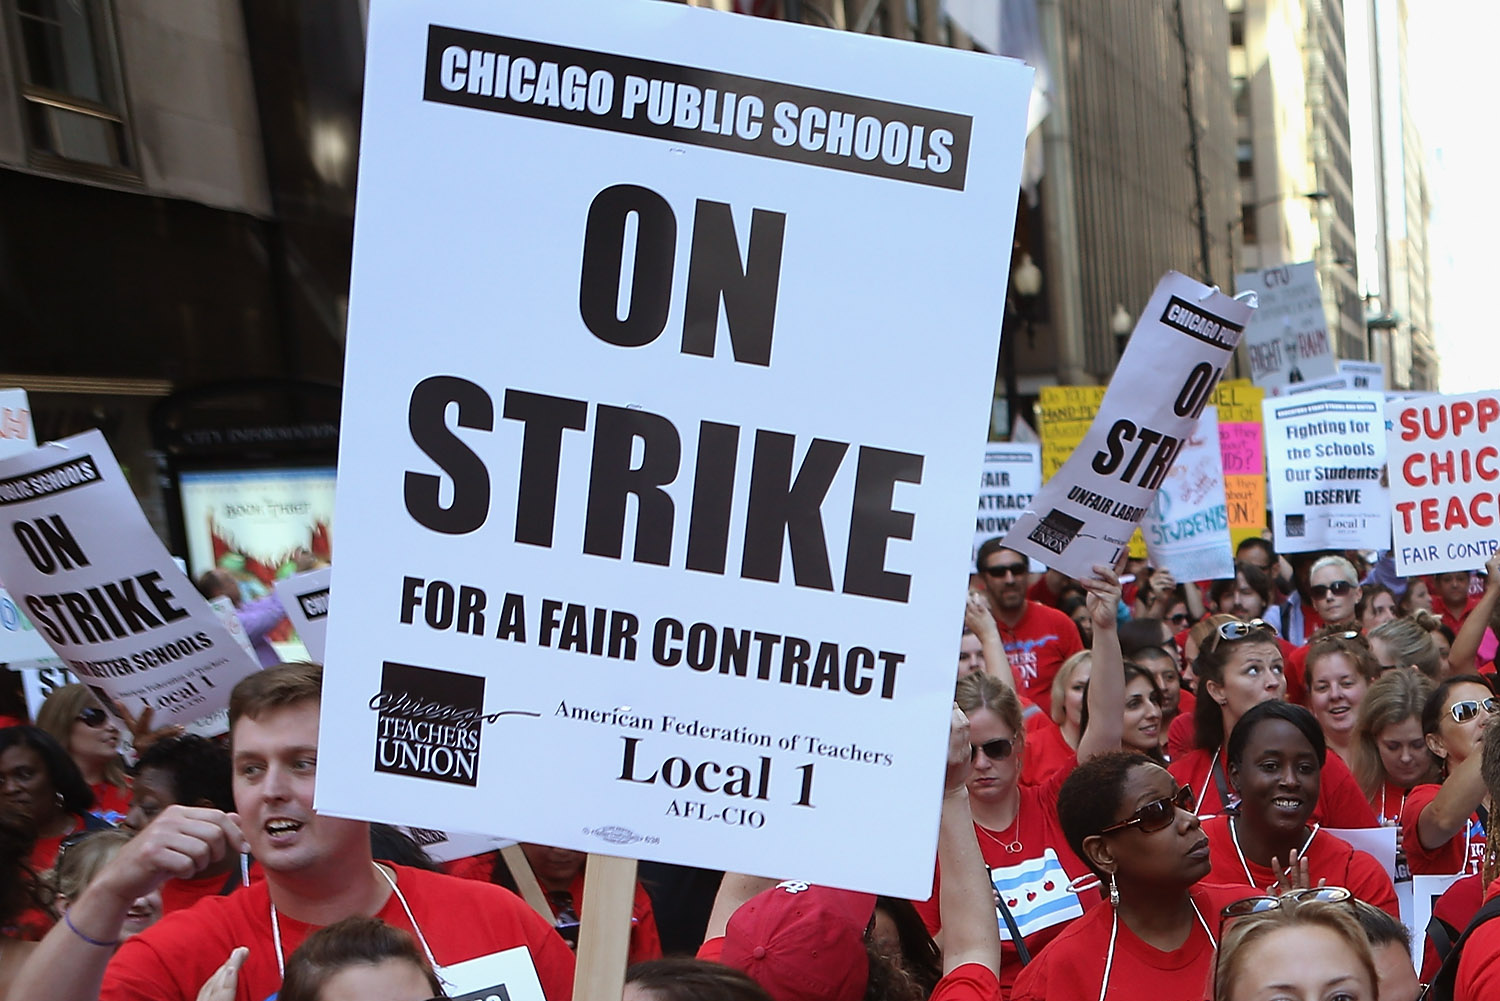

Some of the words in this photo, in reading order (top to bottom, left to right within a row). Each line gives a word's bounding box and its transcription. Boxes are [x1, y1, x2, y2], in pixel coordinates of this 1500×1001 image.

[439, 45, 614, 115] CHICAGO
[622, 74, 764, 141] PUBLIC
[771, 101, 955, 174] SCHOOLS
[578, 182, 786, 367] ON
[1168, 303, 1220, 339] CHICAGO
[1287, 420, 1346, 440] Fighting
[1350, 419, 1370, 433] for
[1287, 447, 1311, 460] the
[1315, 441, 1375, 458] Schools
[403, 375, 925, 604] STRIKE
[1285, 468, 1311, 482] Our
[1314, 464, 1379, 481] Students
[1067, 486, 1114, 515] UNFAIR
[1304, 488, 1361, 506] DESERVE
[1030, 530, 1065, 552] UNION
[1328, 518, 1358, 529] Local
[13, 513, 91, 576] ON
[1403, 545, 1440, 566] FAIR
[26, 570, 191, 646] STRIKE
[132, 632, 214, 672] SCHOOLS
[400, 576, 486, 635] FOR
[497, 592, 527, 644] A
[538, 597, 640, 661] FAIR
[652, 617, 905, 700] CONTRACT
[379, 717, 478, 750] TEACHERS
[554, 700, 654, 733] American
[661, 716, 773, 748] Federation
[778, 734, 802, 752] of
[805, 737, 894, 767] Teachers
[377, 739, 477, 780] UNION
[616, 735, 772, 800] Local
[792, 763, 817, 809] 1
[664, 799, 767, 829] AFL-CIO
